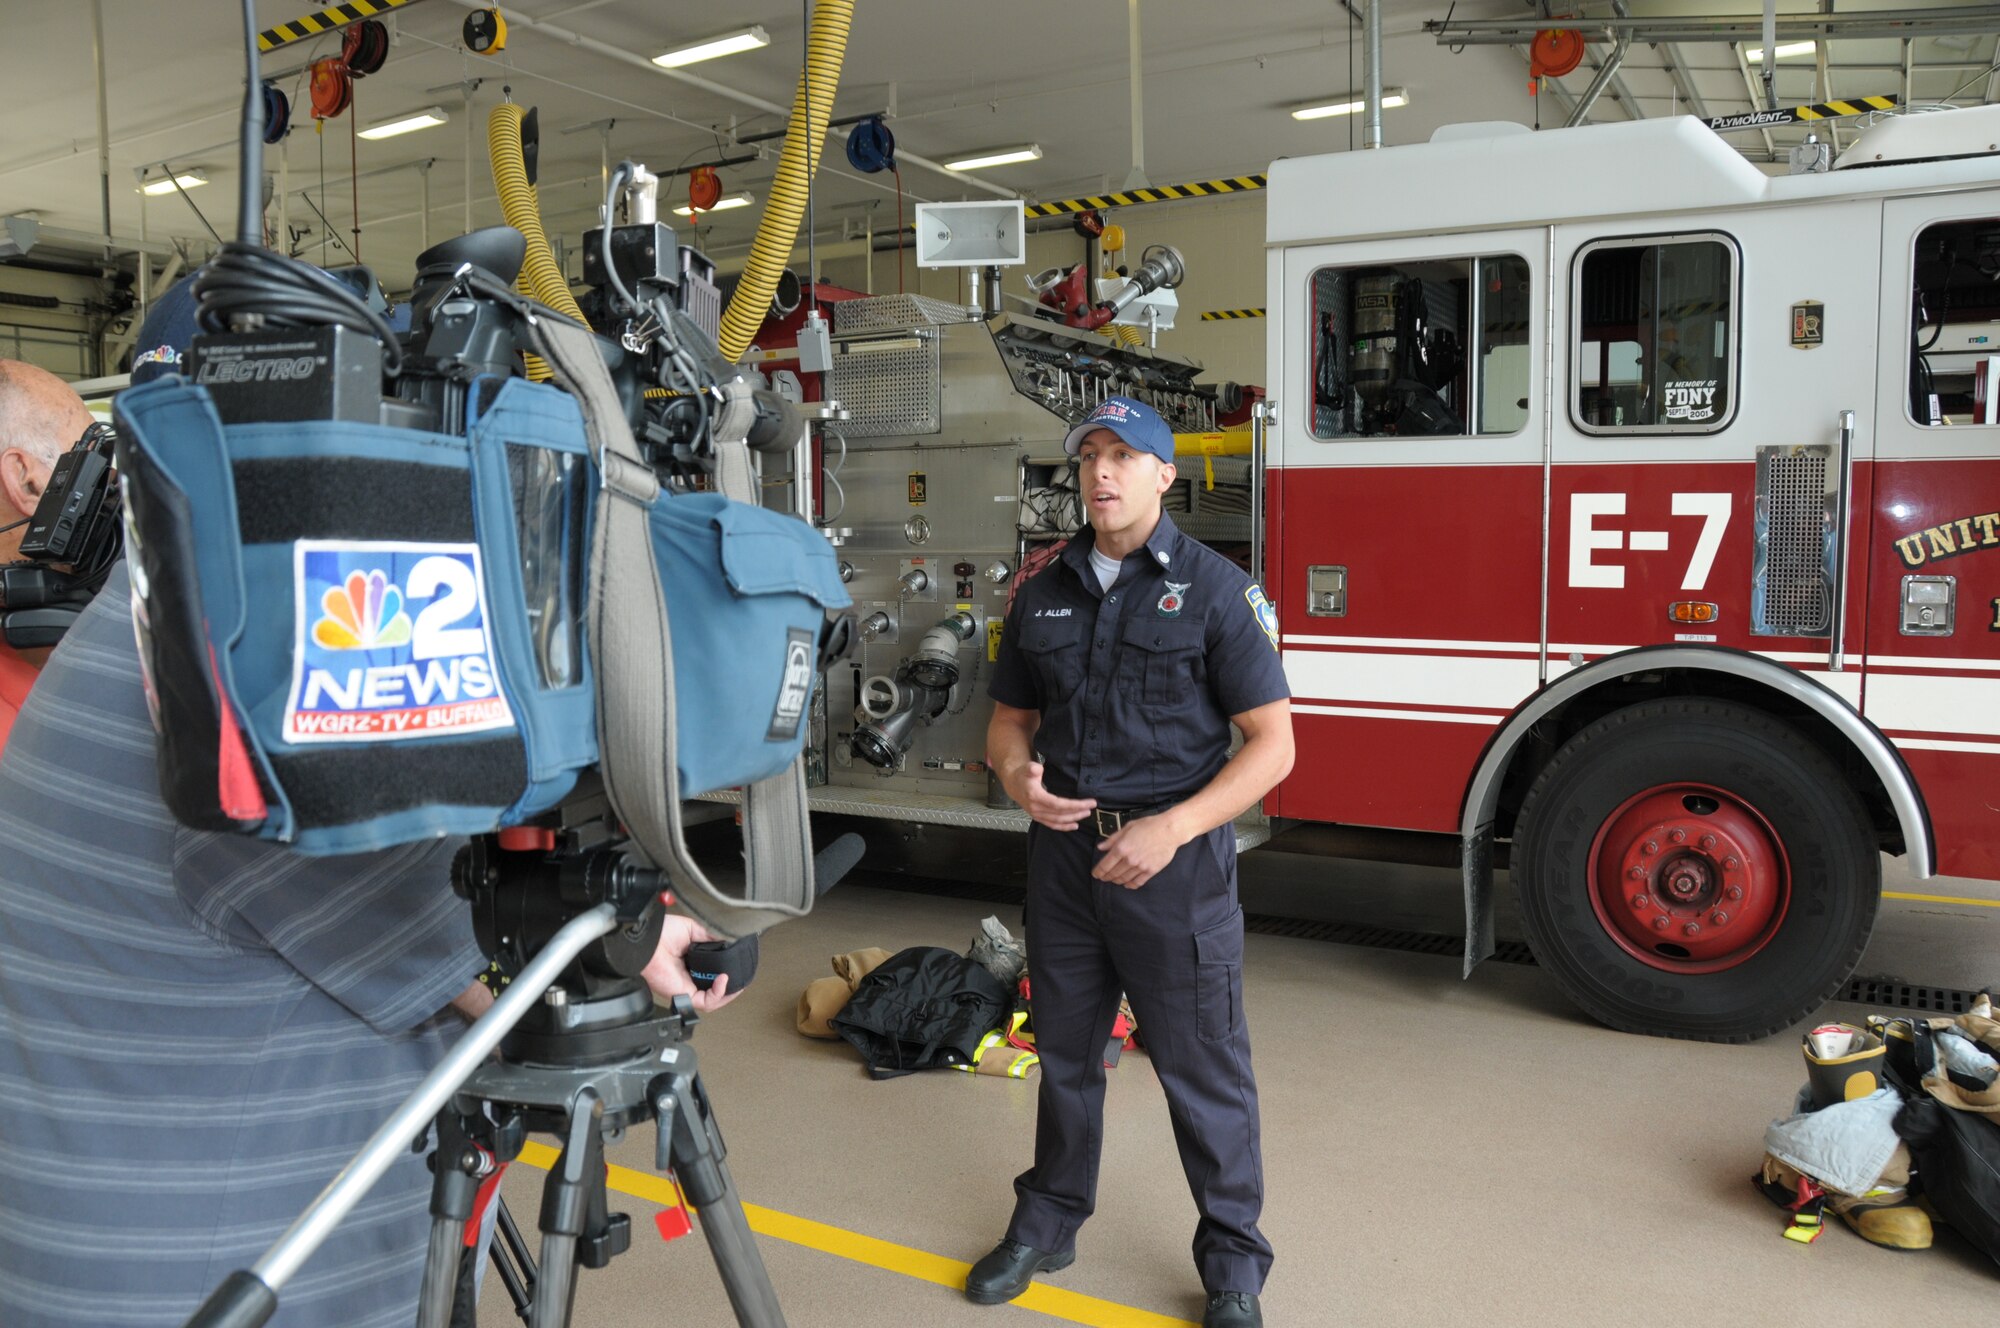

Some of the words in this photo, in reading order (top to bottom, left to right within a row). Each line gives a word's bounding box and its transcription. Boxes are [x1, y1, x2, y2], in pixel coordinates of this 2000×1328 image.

[1358, 296, 1387, 308] MSA
[196, 357, 315, 384] LECTRO
[1675, 380, 1706, 388] MEMORY
[1664, 387, 1716, 406] FDNY
[1689, 410, 1709, 418] 2001
[1568, 492, 1733, 590] E-7
[406, 555, 486, 660] 2
[1035, 609, 1042, 617] J.
[1045, 608, 1072, 617] ALLEN
[303, 656, 494, 709] NEWS
[296, 712, 411, 734] WGRZ-TV
[427, 702, 505, 726] BUFFALO
